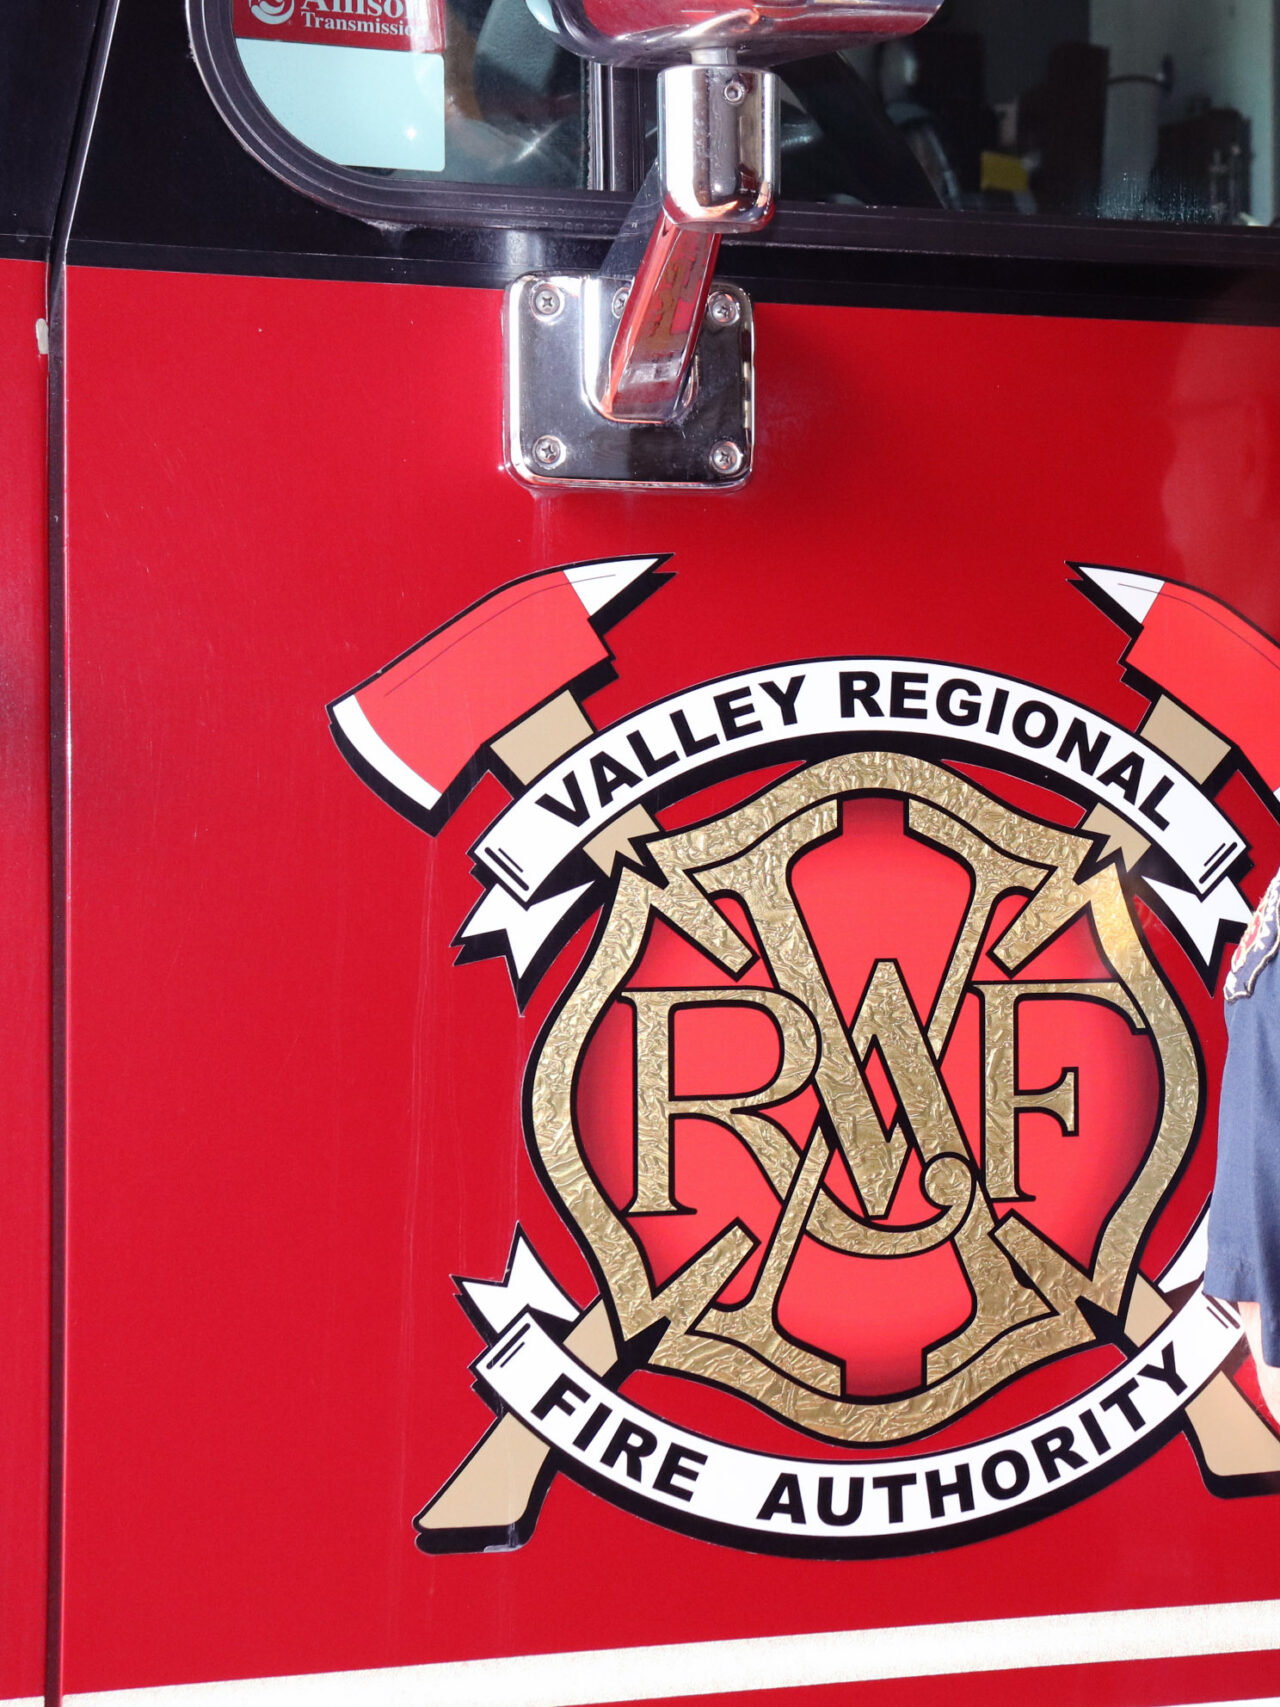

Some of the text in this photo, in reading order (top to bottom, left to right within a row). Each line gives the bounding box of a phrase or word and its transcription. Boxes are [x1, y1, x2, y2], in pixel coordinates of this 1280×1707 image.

[301, 11, 427, 36] Transmissio
[536, 670, 1174, 830] VALLEY REGIONAL
[530, 1341, 1188, 1527] FIRE AUTHORITY
